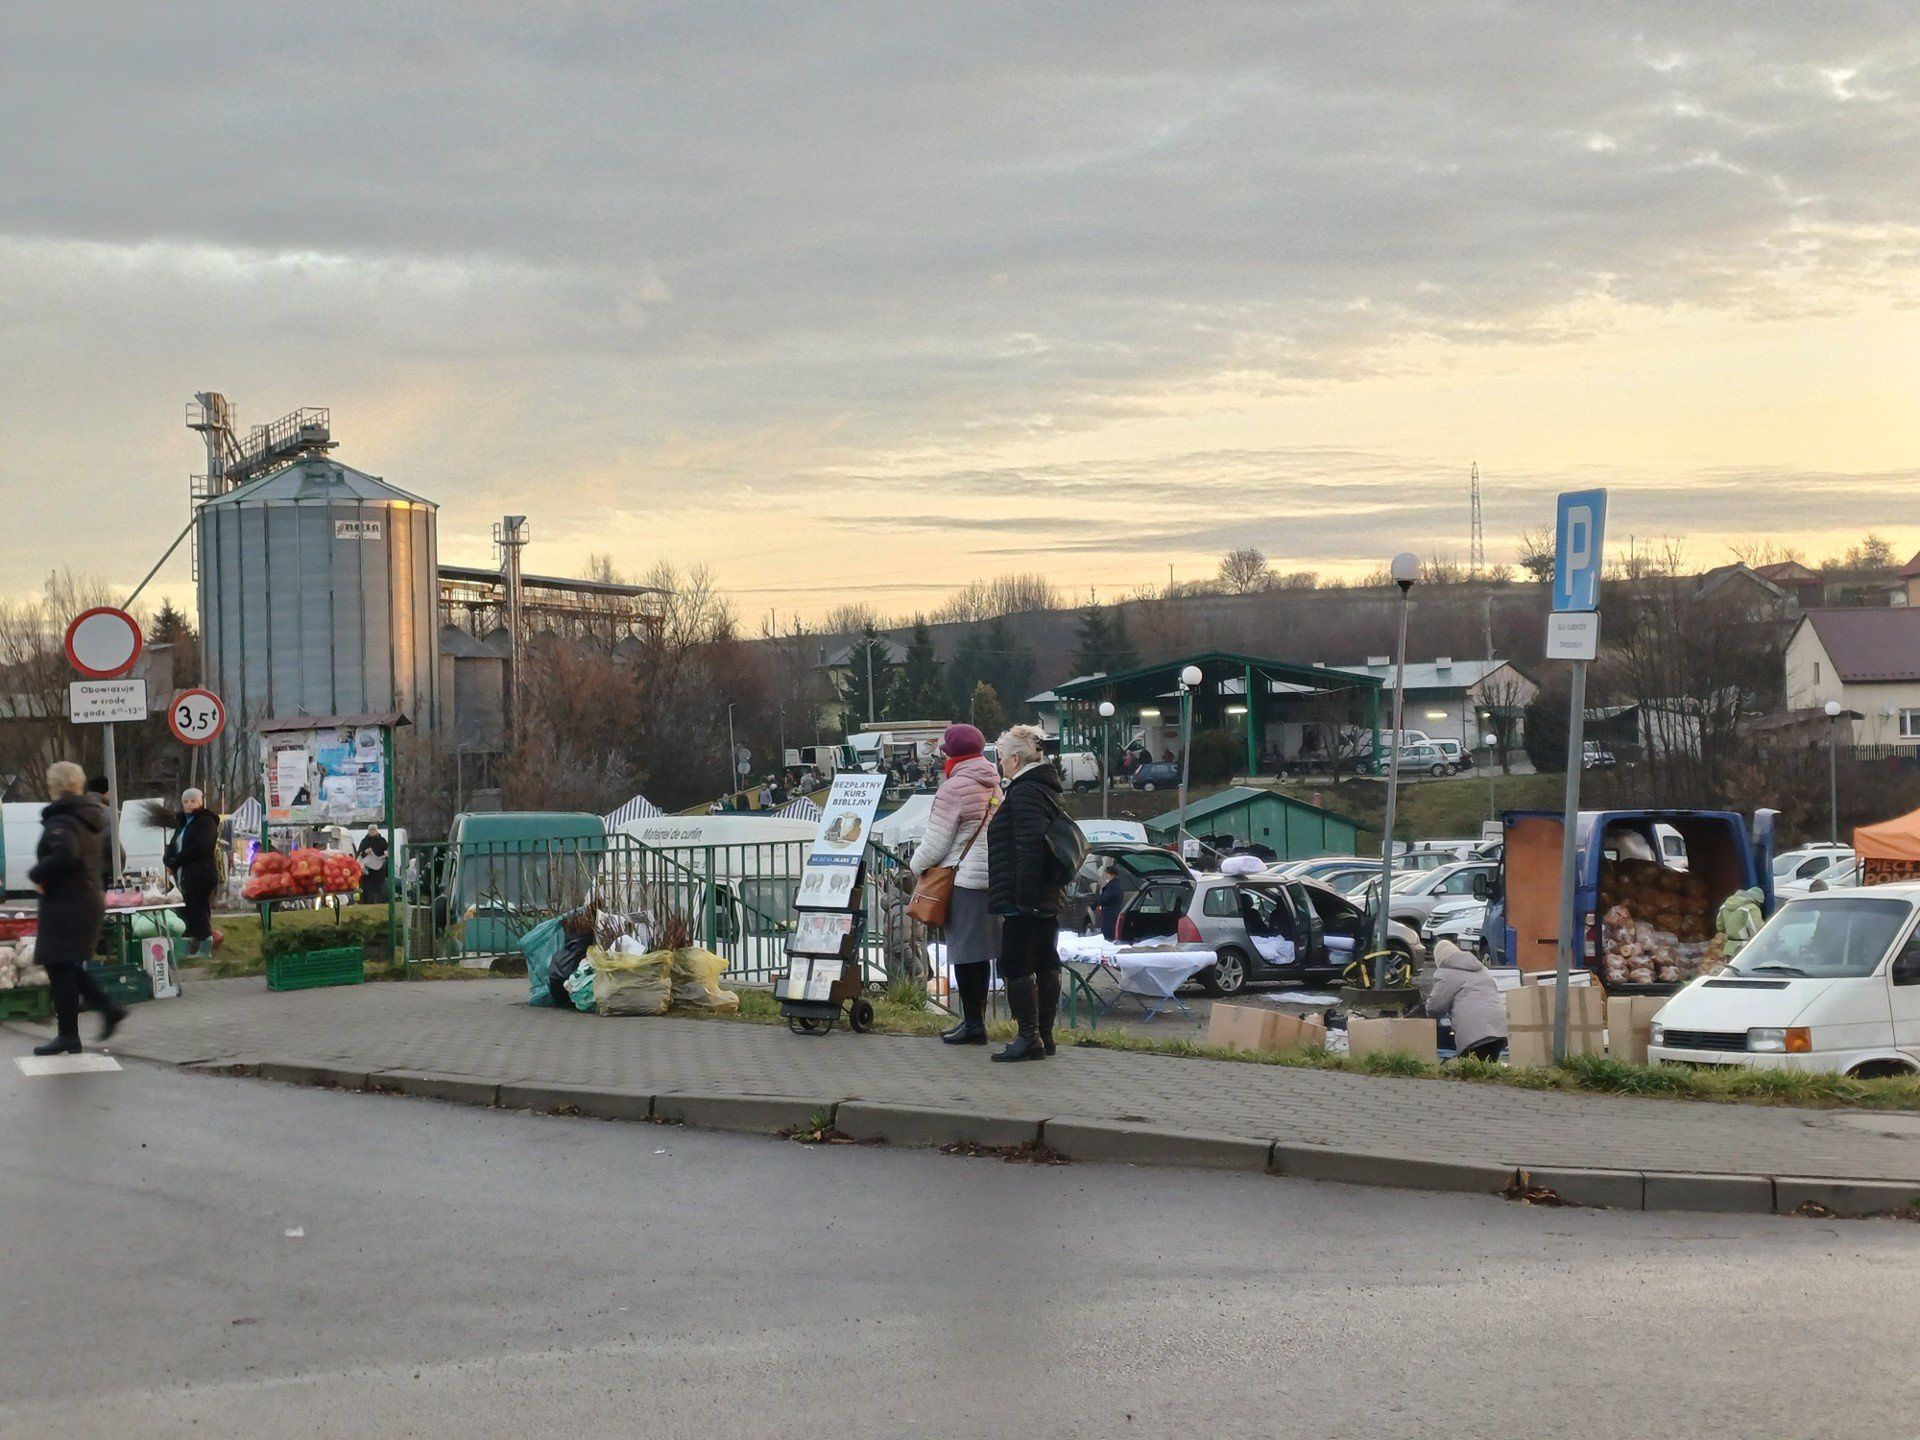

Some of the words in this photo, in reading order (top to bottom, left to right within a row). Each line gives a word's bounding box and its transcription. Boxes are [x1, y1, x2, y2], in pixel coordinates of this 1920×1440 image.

[1565, 505, 1592, 596] P
[843, 790, 867, 798] KURS
[832, 798, 874, 806] BIBLIJNY
